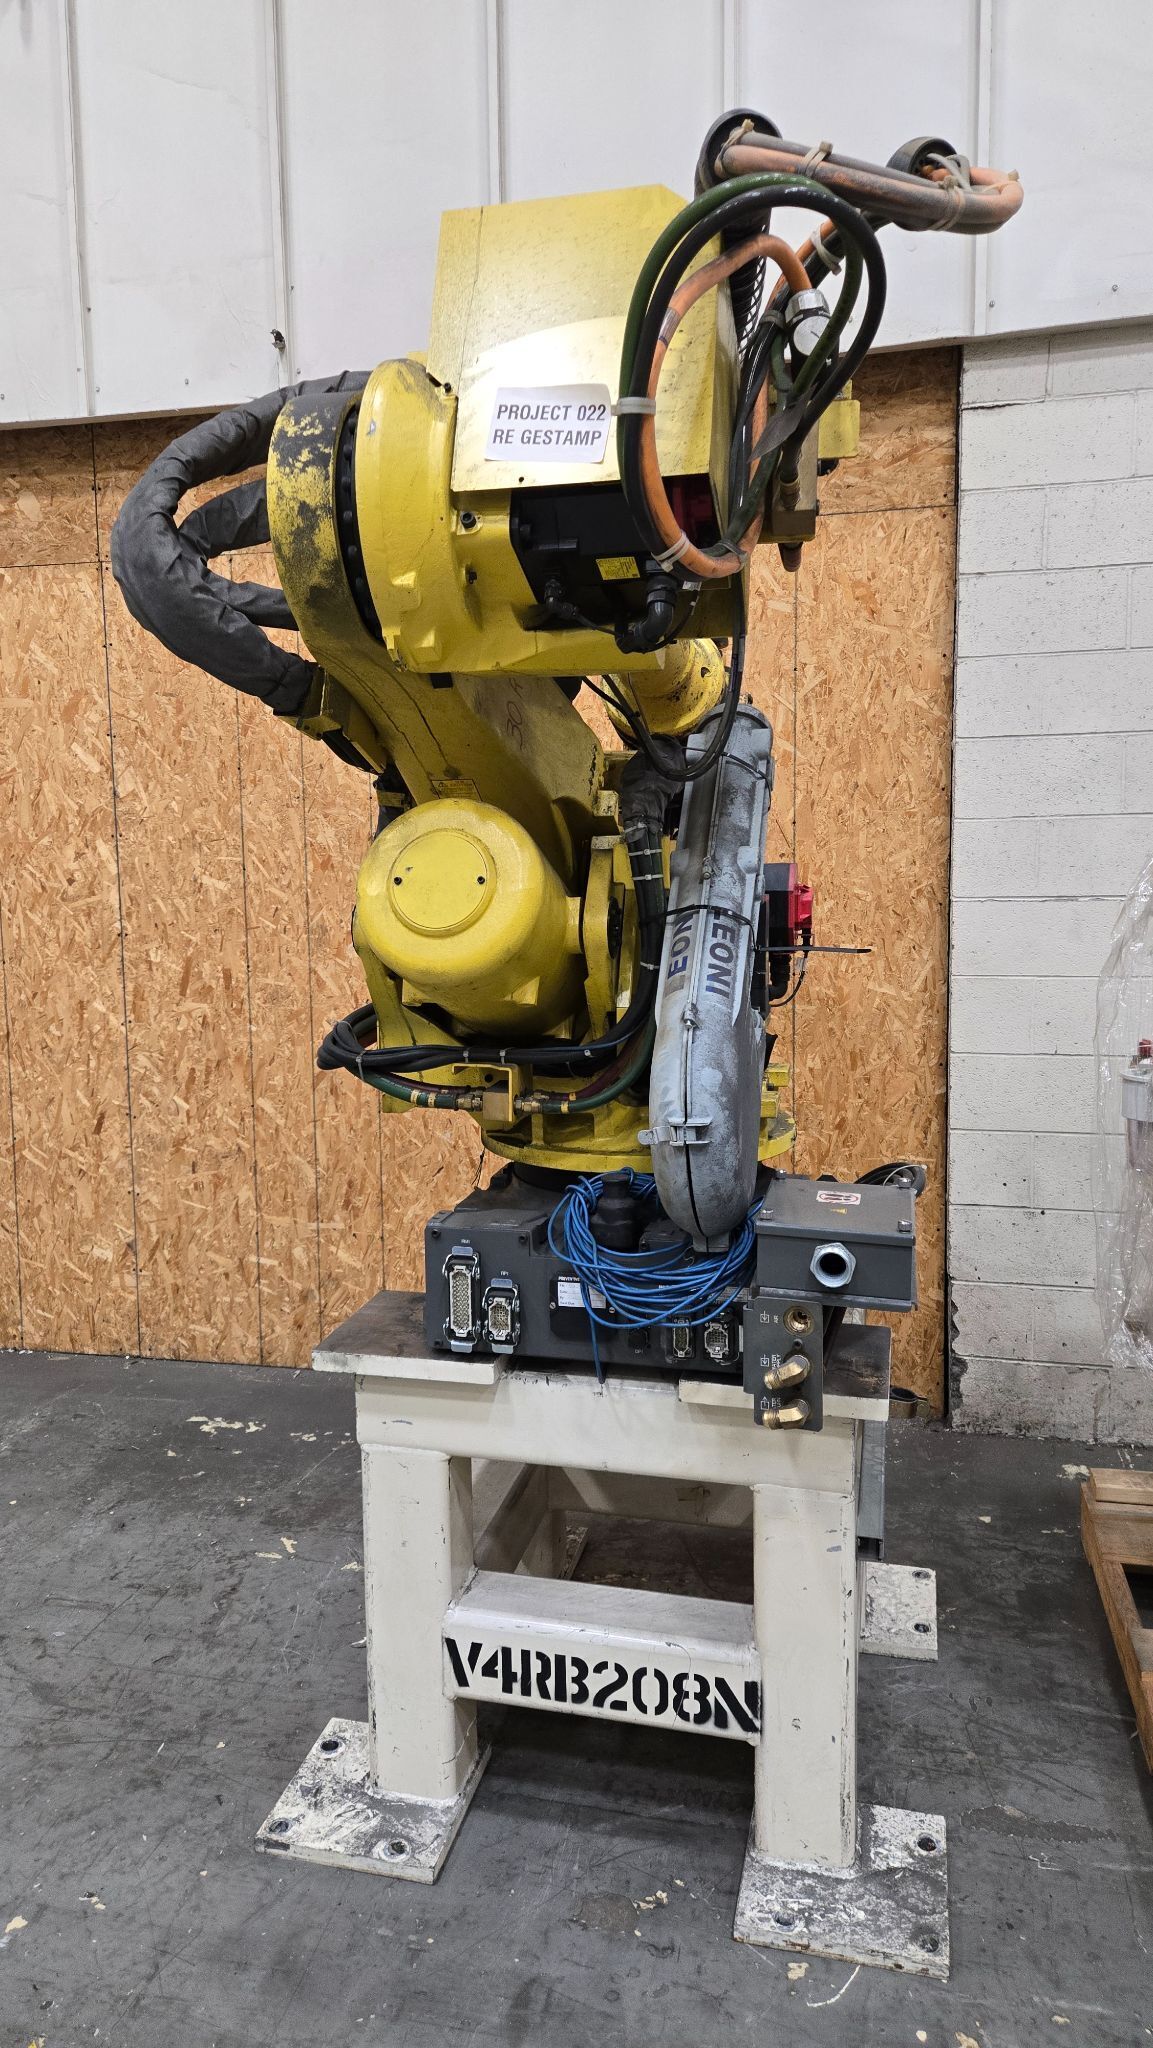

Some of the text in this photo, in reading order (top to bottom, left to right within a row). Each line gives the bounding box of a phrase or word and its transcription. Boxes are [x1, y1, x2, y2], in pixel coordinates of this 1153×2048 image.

[497, 404, 606, 421] PROJECT 022
[493, 429, 602, 446] RE GESTAMP
[444, 1637, 761, 1732] V4RB208N
